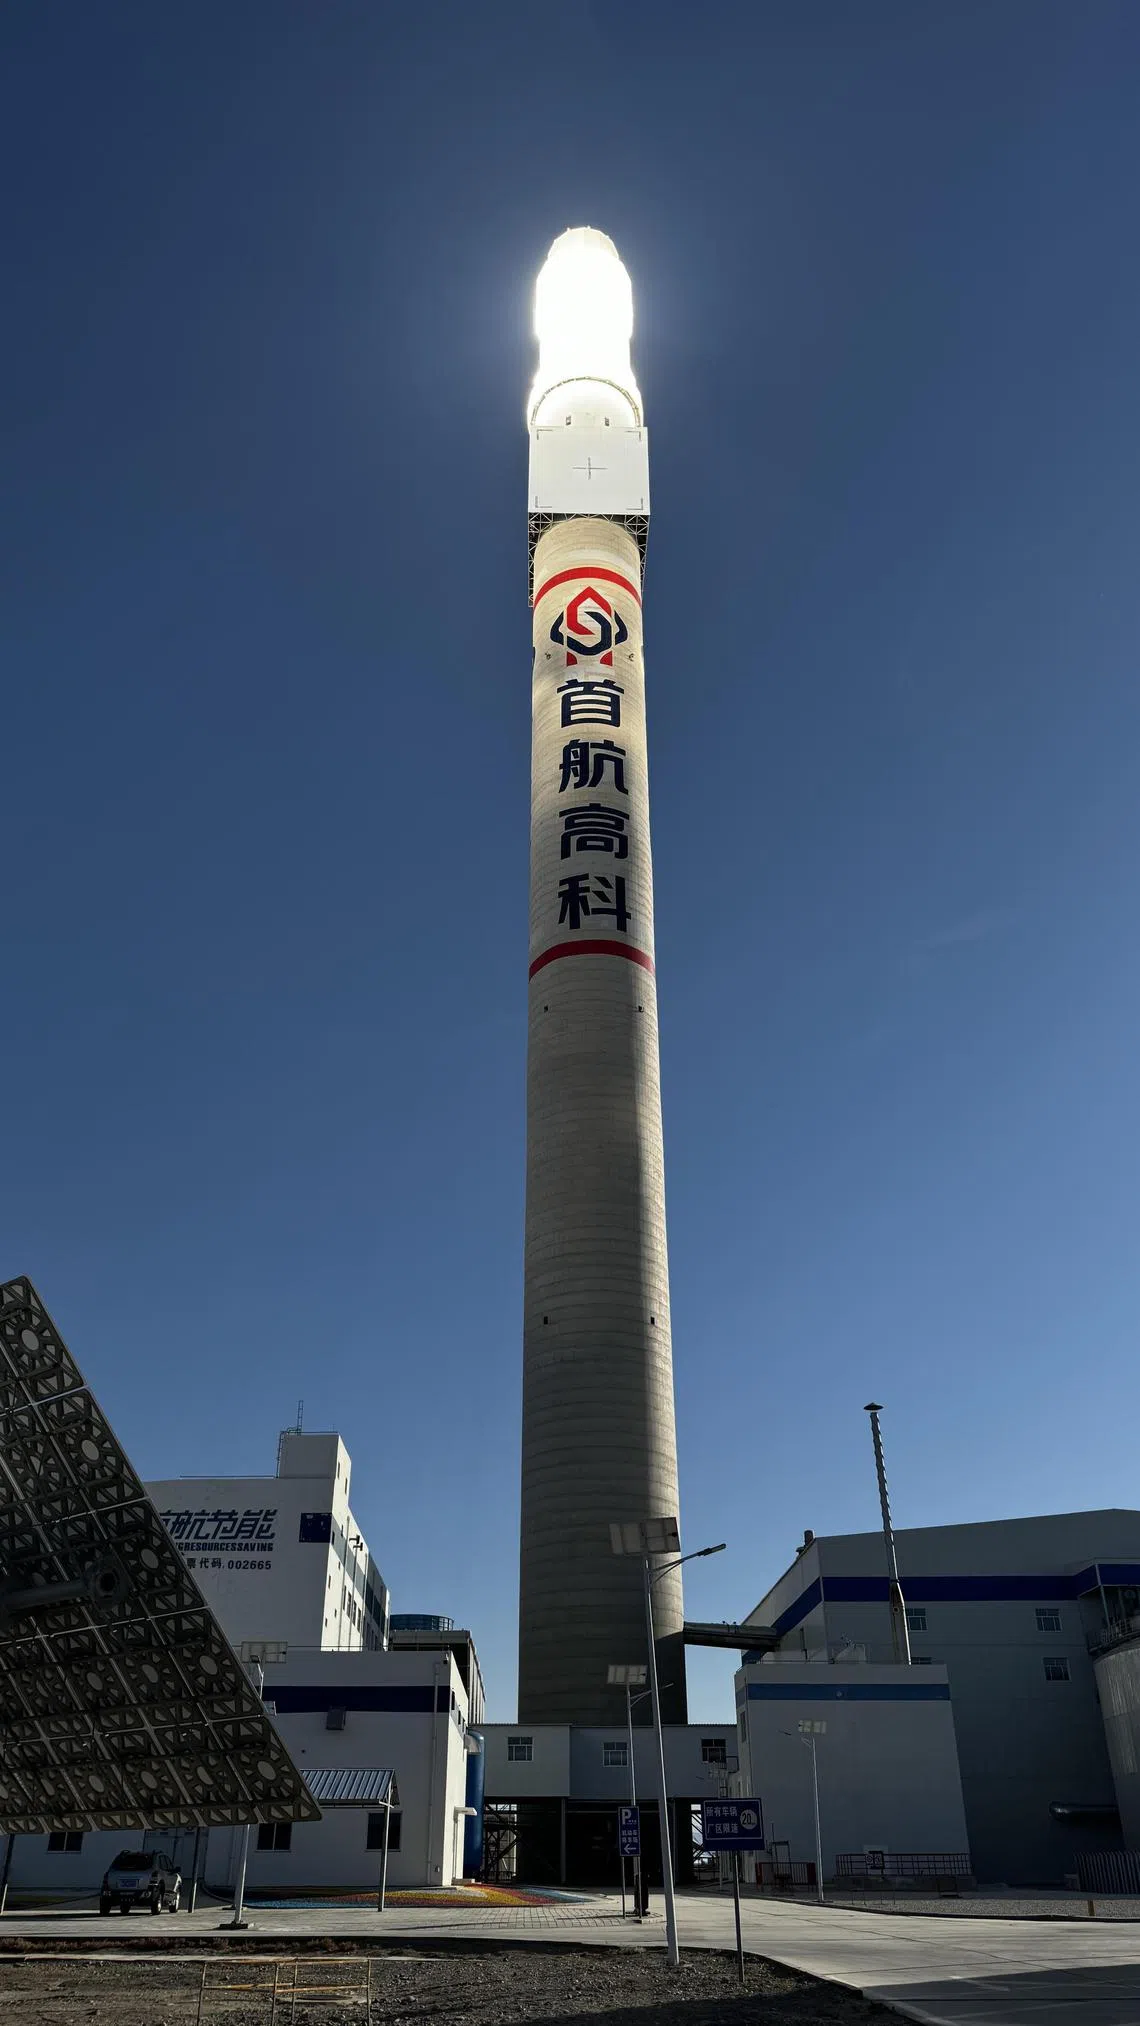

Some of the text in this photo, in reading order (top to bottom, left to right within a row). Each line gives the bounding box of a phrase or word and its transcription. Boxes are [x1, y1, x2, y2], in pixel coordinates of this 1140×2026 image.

[557, 679, 632, 932] 首航高科
[175, 1542, 273, 1552] GRESOURCESSAVING
[621, 1808, 632, 1825] P
[706, 1806, 738, 1817] 所有车辆
[707, 1823, 739, 1834] 厂区限速
